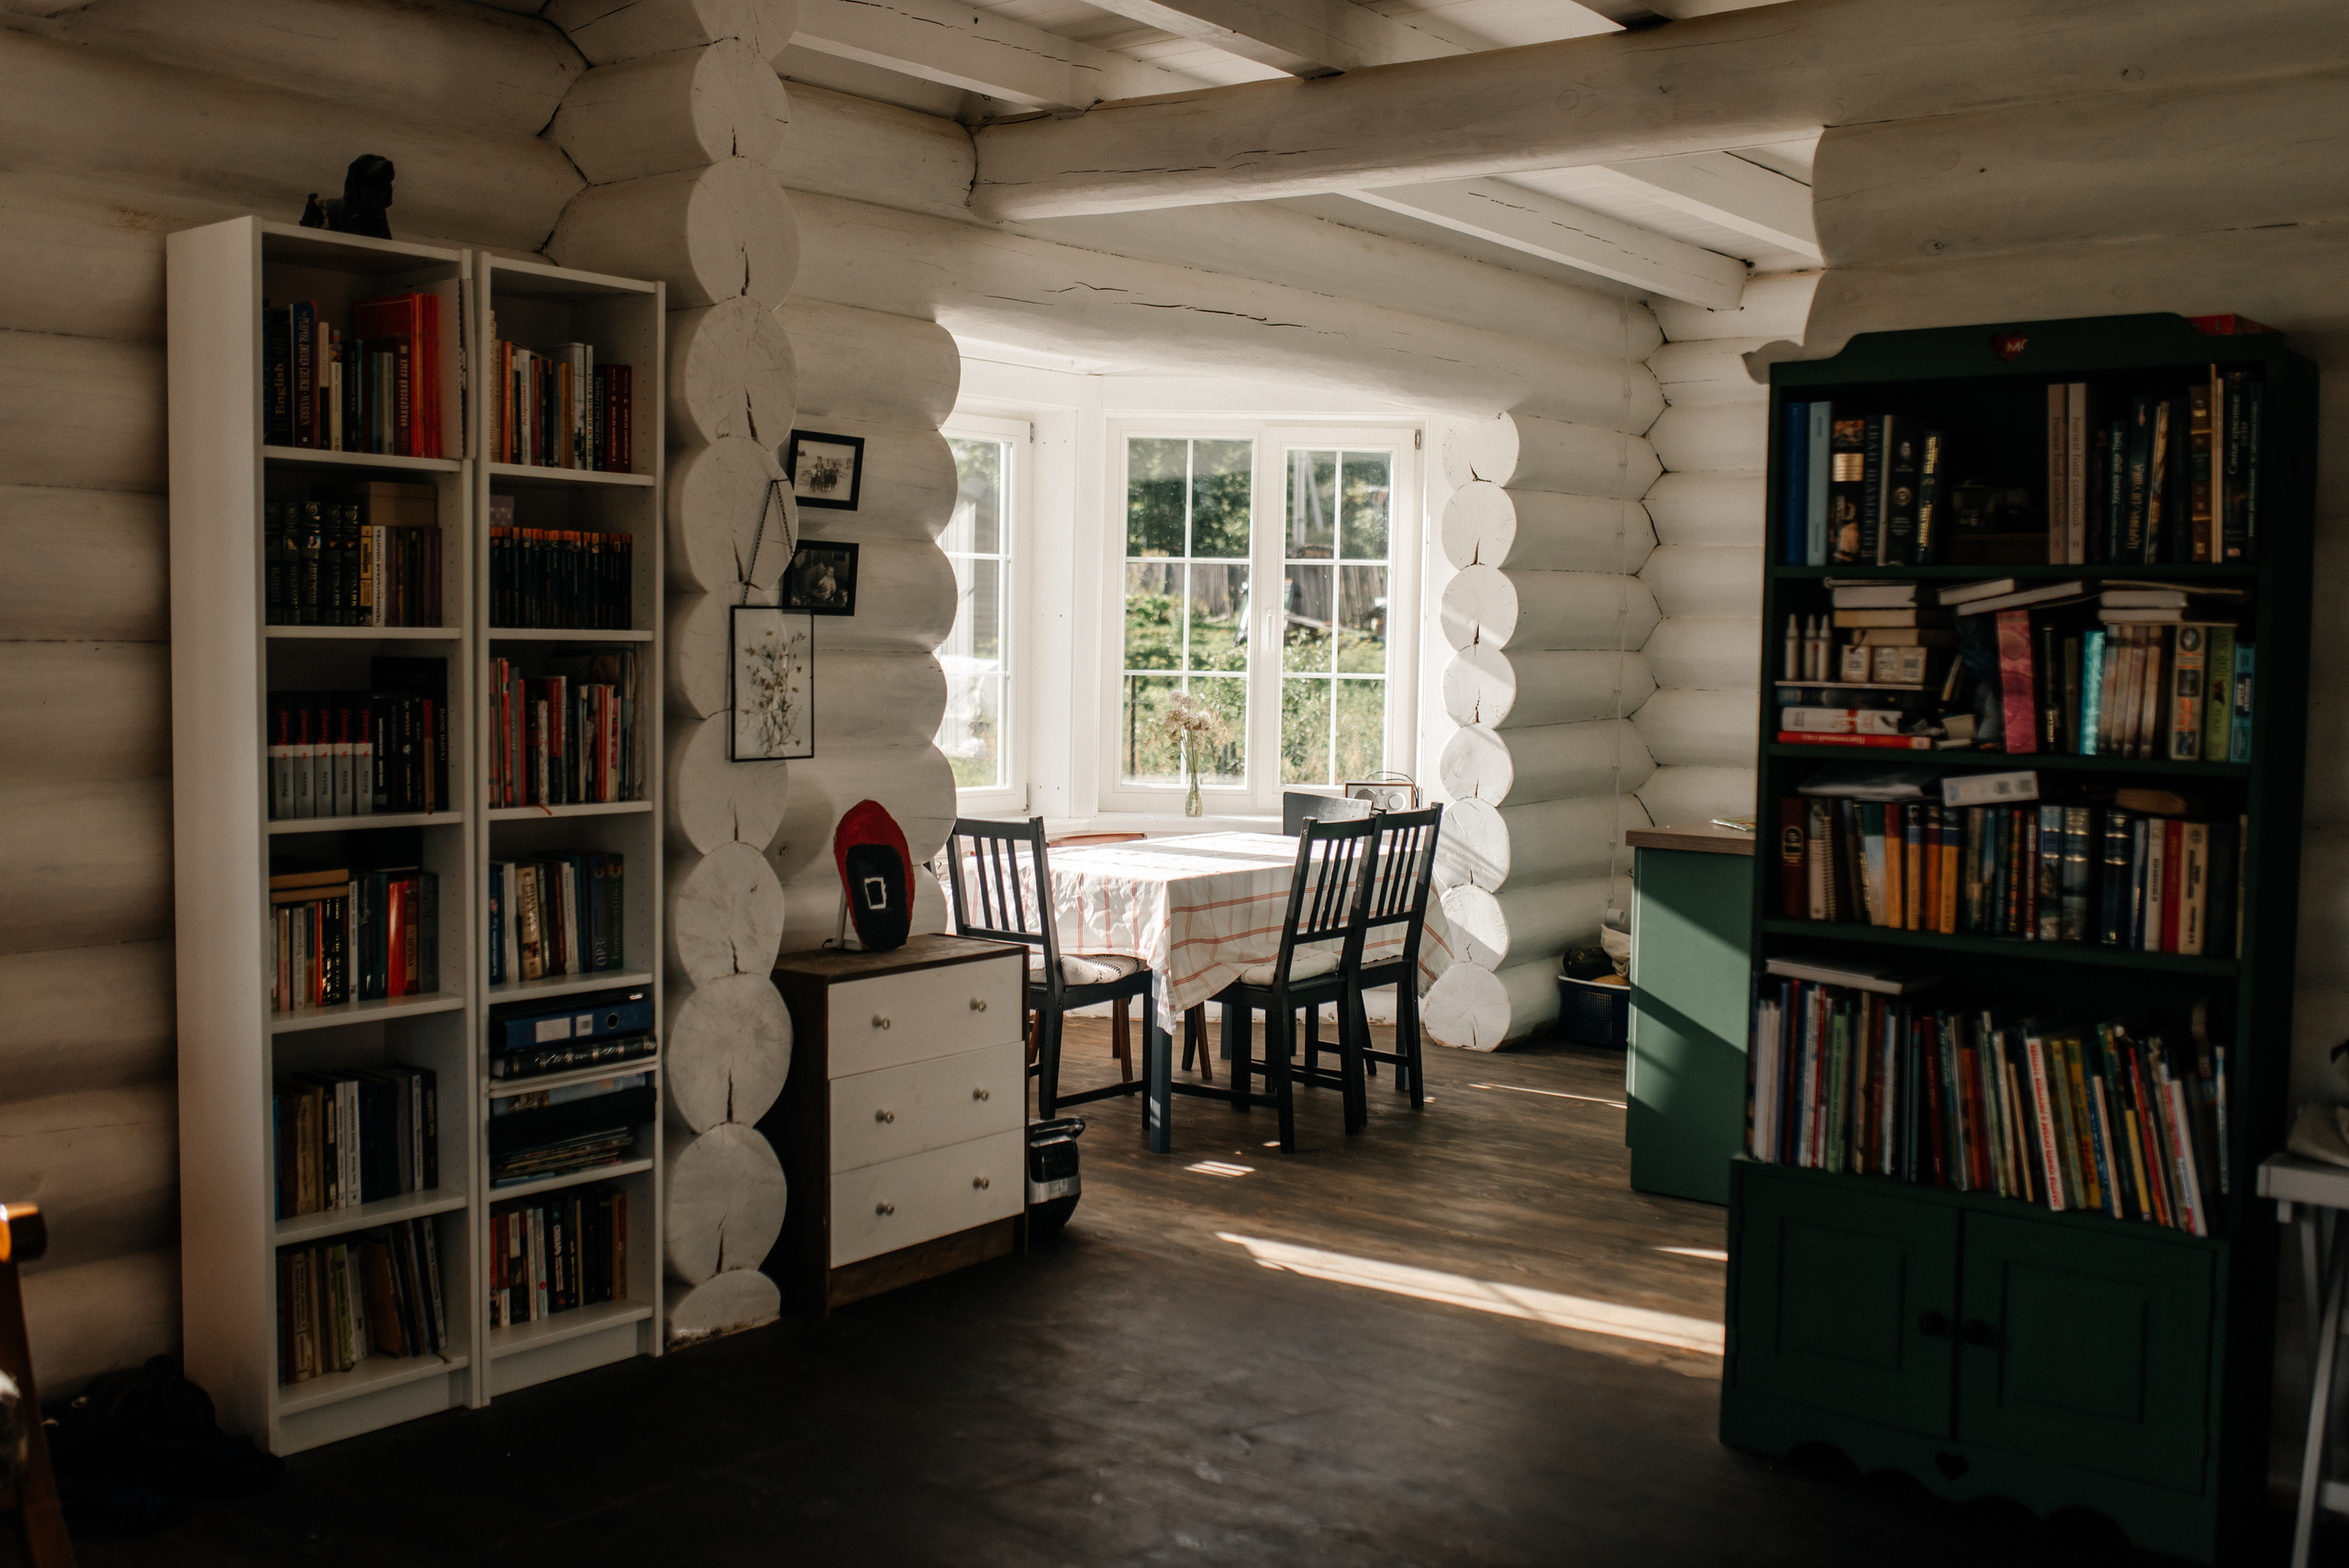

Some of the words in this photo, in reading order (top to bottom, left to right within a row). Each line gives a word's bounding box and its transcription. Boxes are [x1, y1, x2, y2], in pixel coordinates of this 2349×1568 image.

[298, 317, 310, 343] PURPOSE
[298, 344, 310, 366] DRIVEN
[399, 359, 408, 377] ЯЗЫК
[274, 361, 287, 415] English
[298, 367, 310, 392] CHURCH
[298, 395, 310, 426] WARREN
[398, 380, 408, 428] ФРАНЦУЗСКИЙ
[2054, 417, 2064, 450] honest
[2073, 417, 2082, 450] honest
[2112, 431, 2122, 450] Тома
[2054, 454, 2064, 476] food
[2073, 454, 2082, 476] food
[2228, 442, 2240, 474] Самые
[2054, 479, 2064, 528] cookbook
[2073, 479, 2082, 528] cookbook
[2112, 474, 2122, 505] Хижина
[1864, 469, 1876, 546] ШАМЯКІН
[282, 752, 287, 761] 2
[301, 752, 306, 761] 3
[341, 751, 347, 759] 5
[362, 751, 369, 759] 6
[553, 1225, 562, 1256] СЛОВАРЬ
